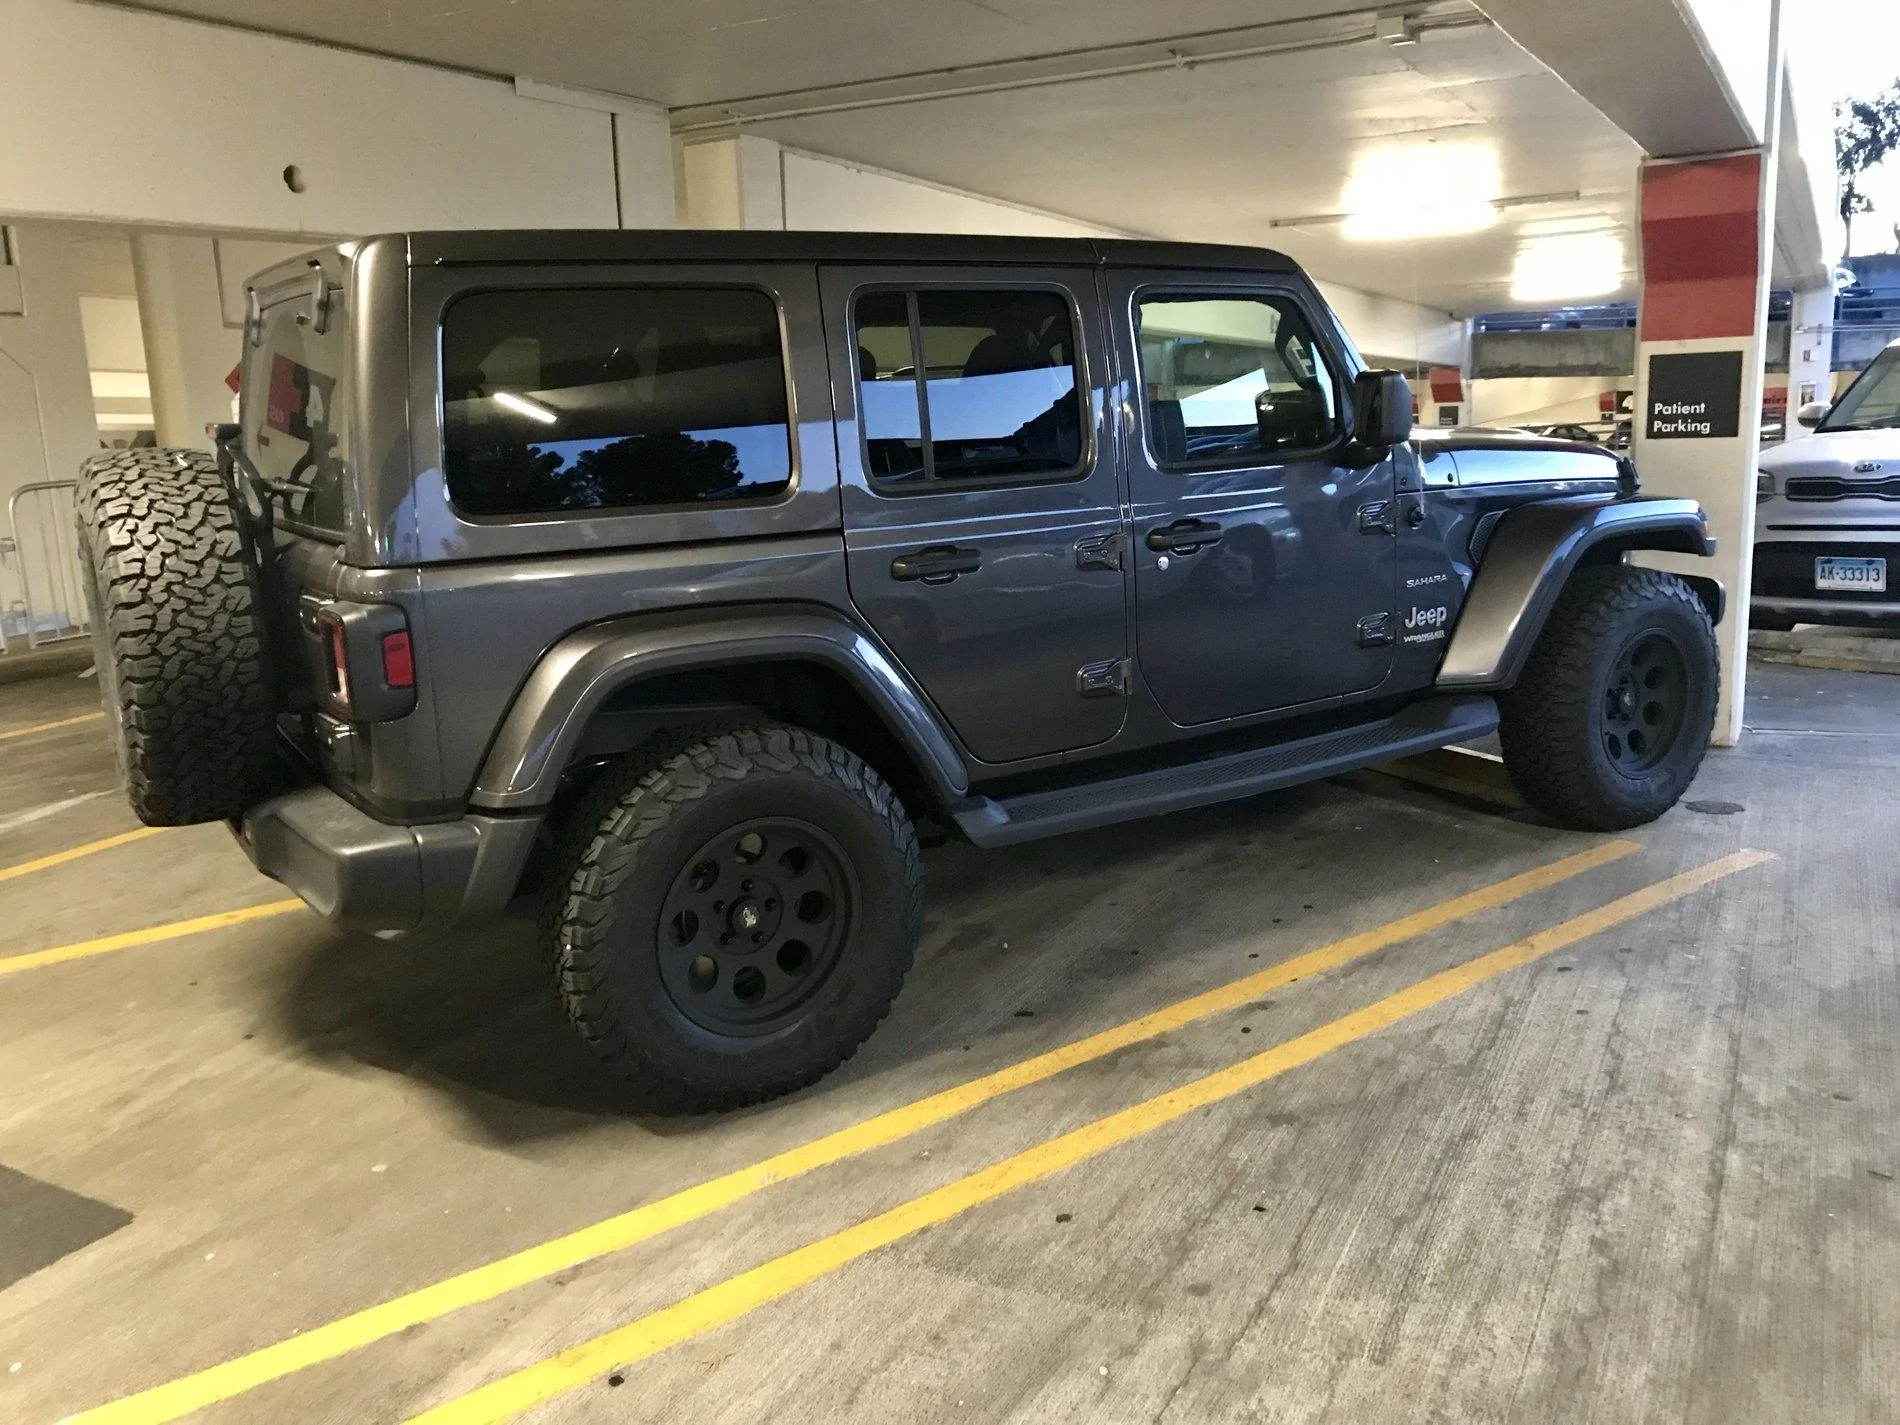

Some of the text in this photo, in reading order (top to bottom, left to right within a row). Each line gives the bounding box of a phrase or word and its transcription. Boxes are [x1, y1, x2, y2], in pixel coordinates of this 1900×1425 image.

[1654, 402, 1705, 414] Patient
[1653, 419, 1711, 434] Parking
[1406, 574, 1447, 588] SAHARA
[1404, 606, 1447, 628] Jeep
